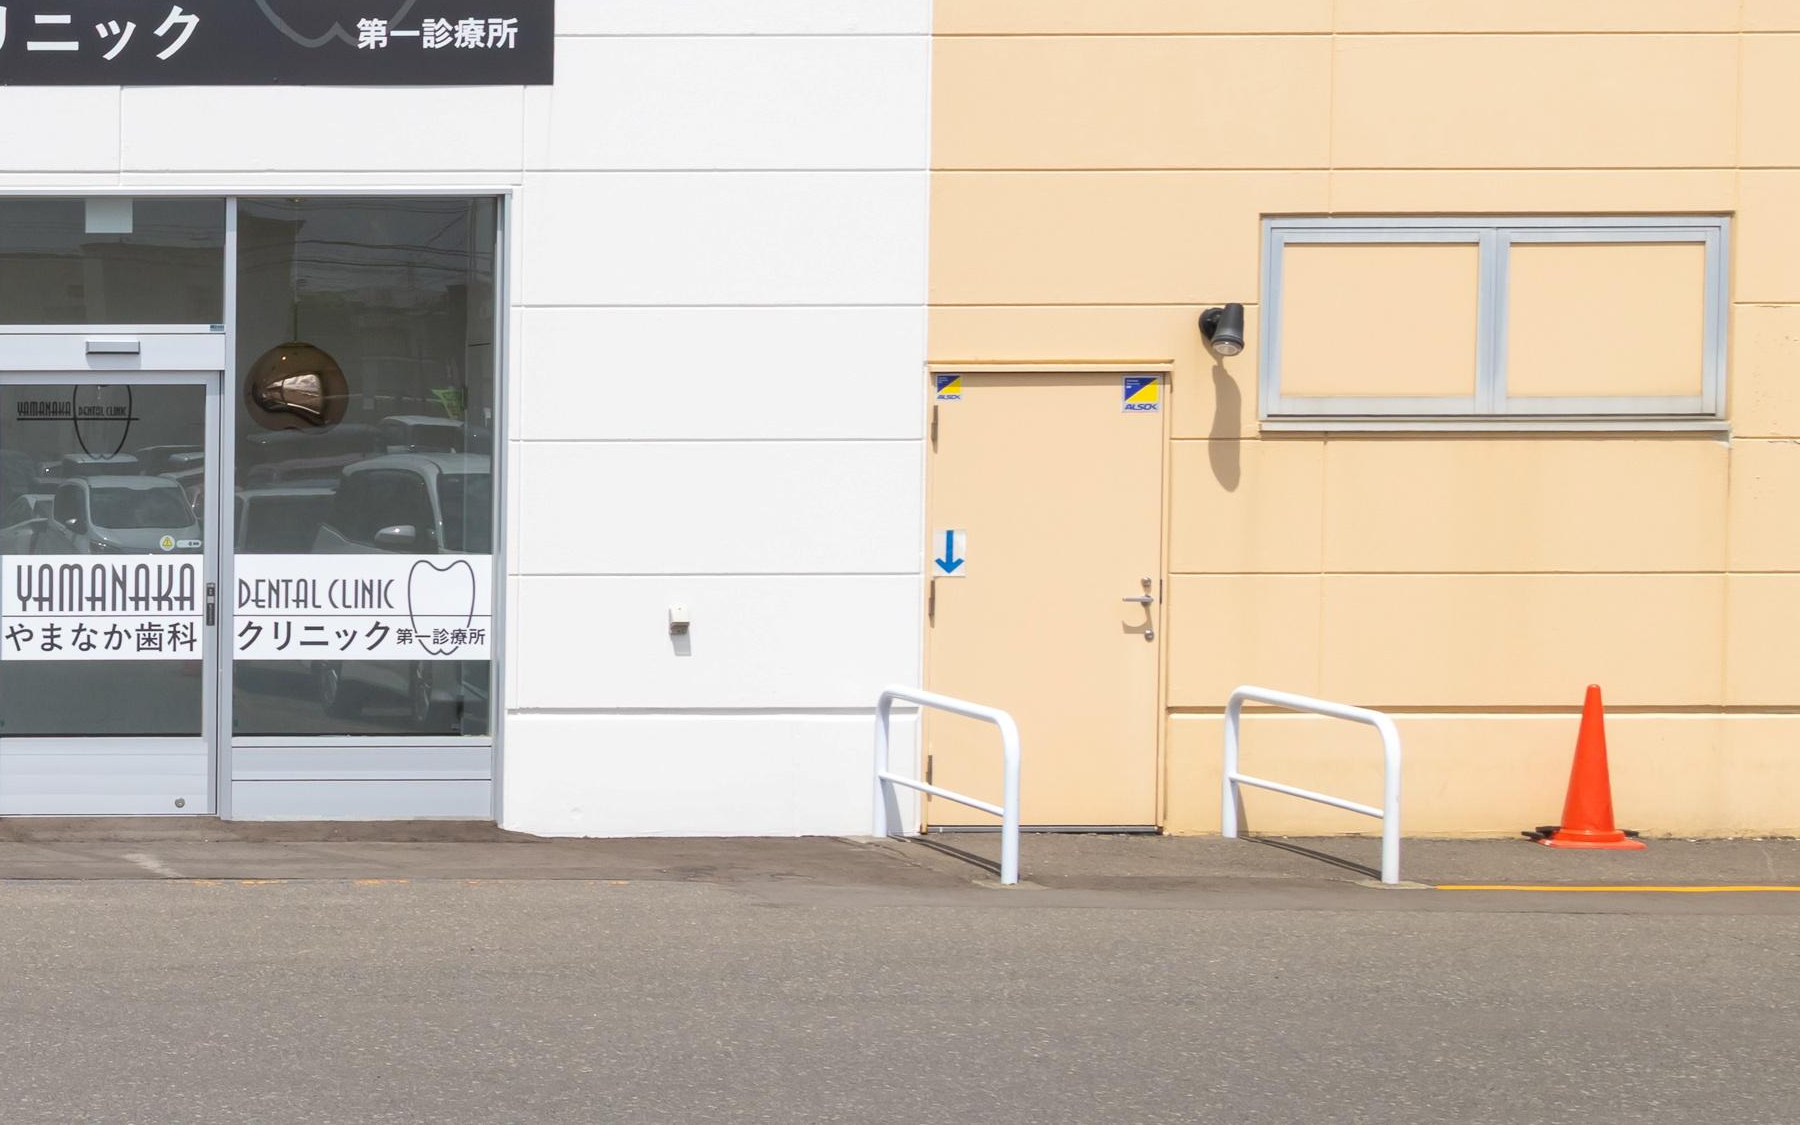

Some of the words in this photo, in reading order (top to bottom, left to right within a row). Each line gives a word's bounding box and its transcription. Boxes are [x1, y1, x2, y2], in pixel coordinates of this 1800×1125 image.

[356, 17, 519, 50] 第一診療所
[17, 401, 71, 416] YAMANAKA
[1124, 403, 1158, 411] ALSOK
[16, 563, 195, 612] YAMANAKA
[238, 578, 322, 609] DENTAL
[328, 578, 395, 609] CLINIC
[5, 621, 198, 652] やまなか歯科
[237, 620, 390, 651] クリニック
[395, 627, 486, 646] 第一診療所
